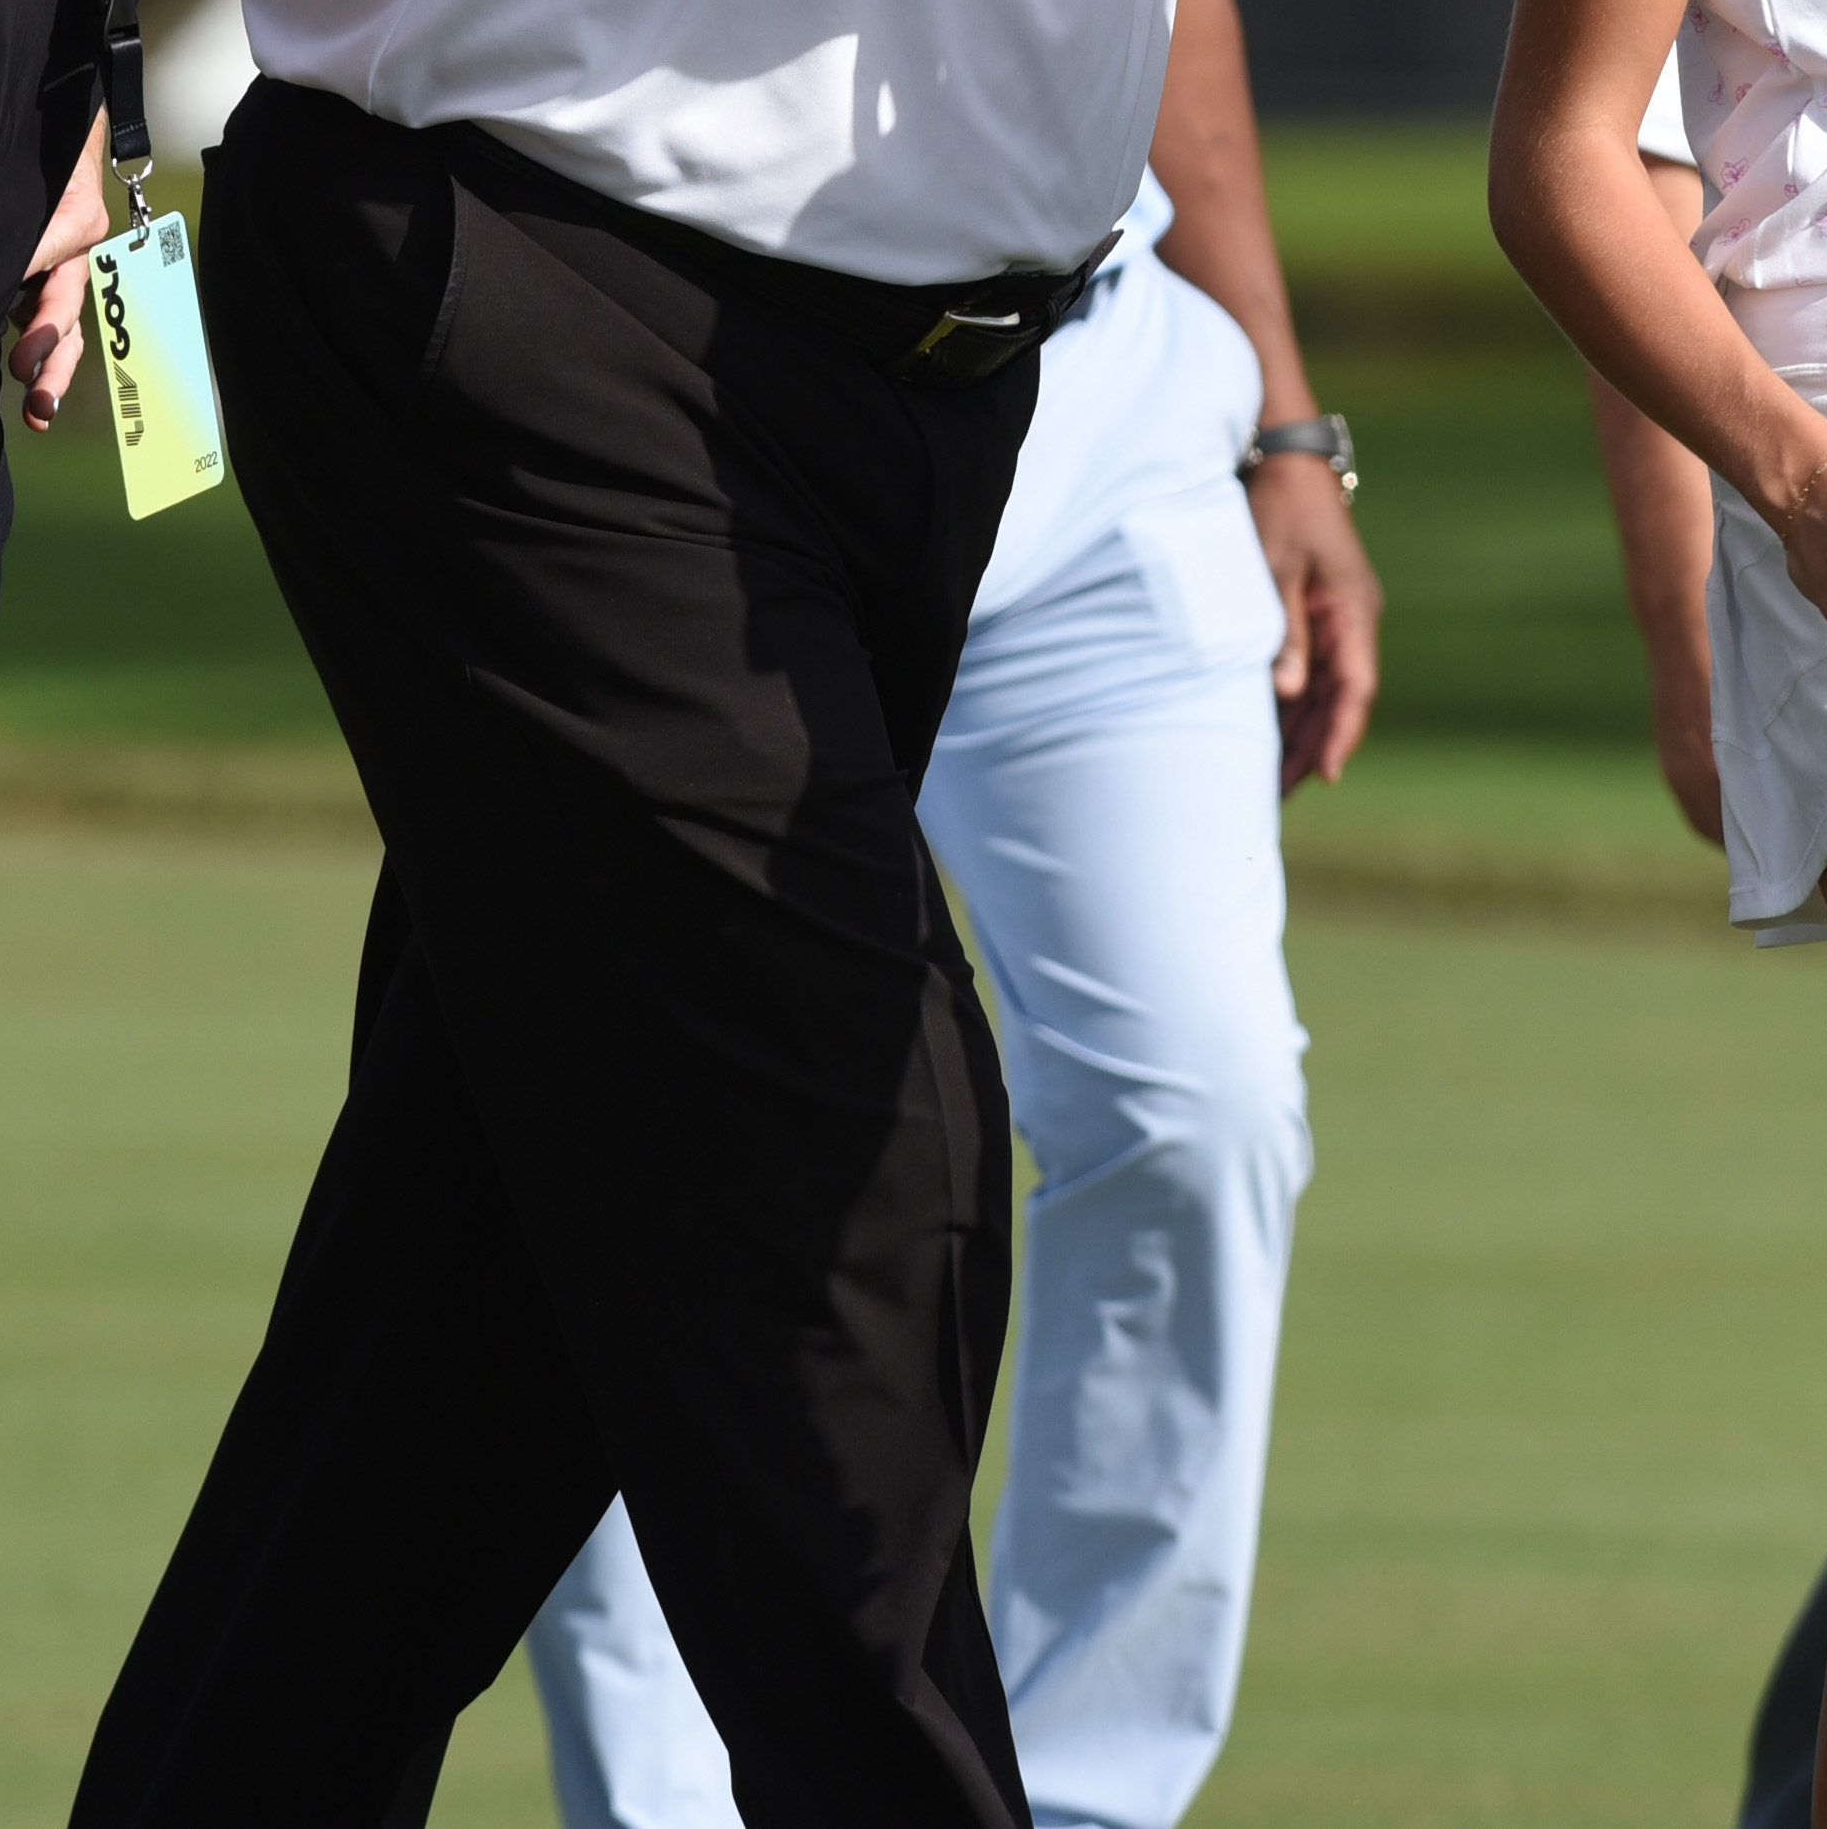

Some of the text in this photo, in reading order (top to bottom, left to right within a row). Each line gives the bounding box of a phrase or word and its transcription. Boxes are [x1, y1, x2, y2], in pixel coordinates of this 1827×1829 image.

[95, 253, 145, 447] LIV GOLF
[193, 451, 219, 474] 2022
